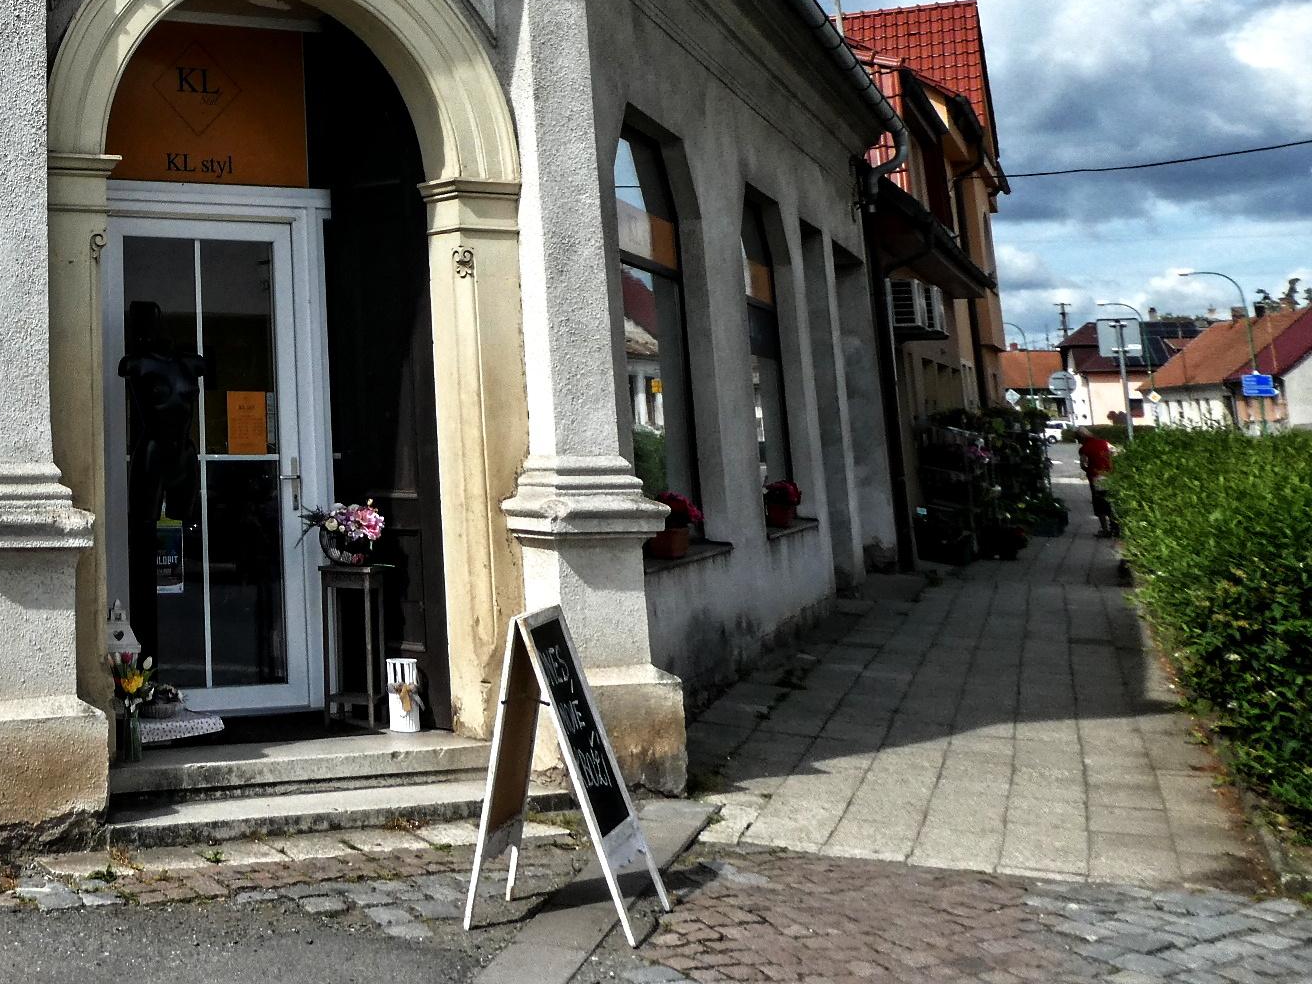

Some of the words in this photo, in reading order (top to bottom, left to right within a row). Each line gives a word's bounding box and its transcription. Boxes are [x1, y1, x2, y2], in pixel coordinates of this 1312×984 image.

[176, 66, 220, 94] KL
[165, 152, 196, 172] KL
[200, 154, 233, 177] styl
